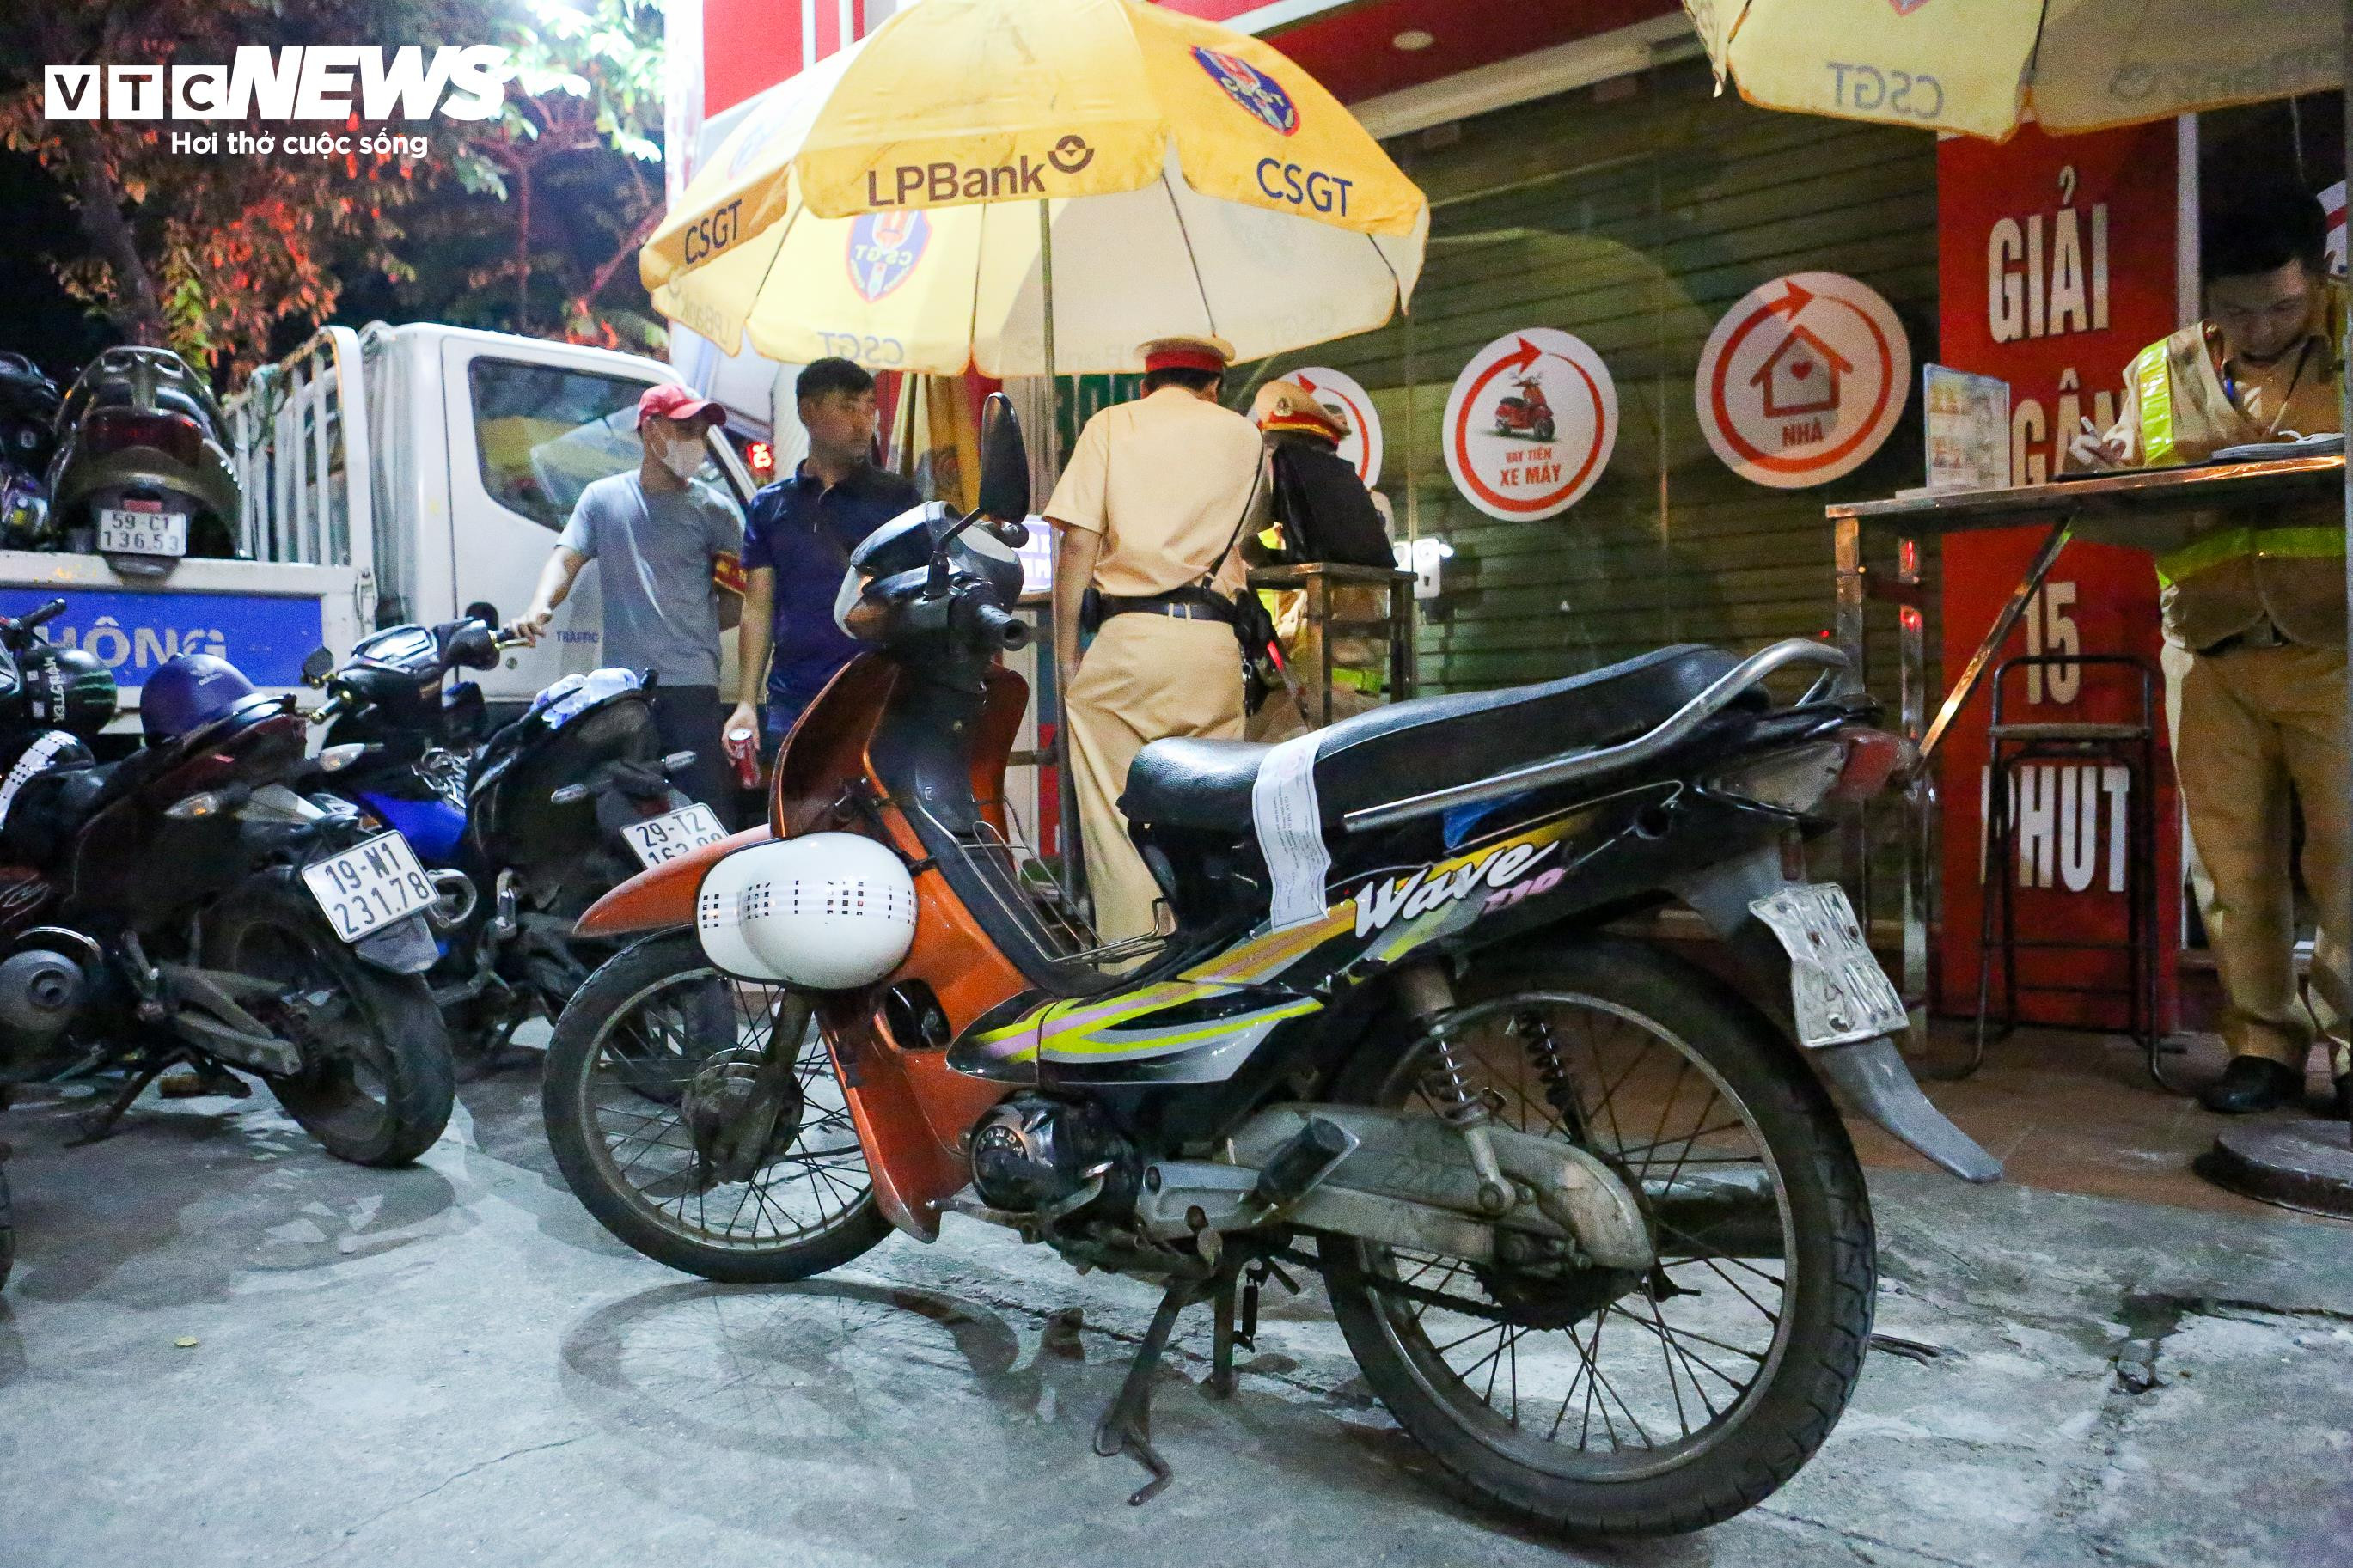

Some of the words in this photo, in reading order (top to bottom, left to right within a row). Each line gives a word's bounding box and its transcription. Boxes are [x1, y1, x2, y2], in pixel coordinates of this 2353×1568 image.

[867, 155, 1047, 207] LPBank
[1256, 157, 1354, 217] CSGT
[684, 198, 743, 265] CSGT
[1988, 164, 2109, 344] GIẢI
[1500, 467, 1519, 486] XE
[556, 630, 599, 643] TRAFFIC
[2022, 582, 2081, 705] 15
[636, 811, 706, 848] 29-T2
[333, 871, 430, 935] 231.78
[1354, 839, 1561, 939] Wave
